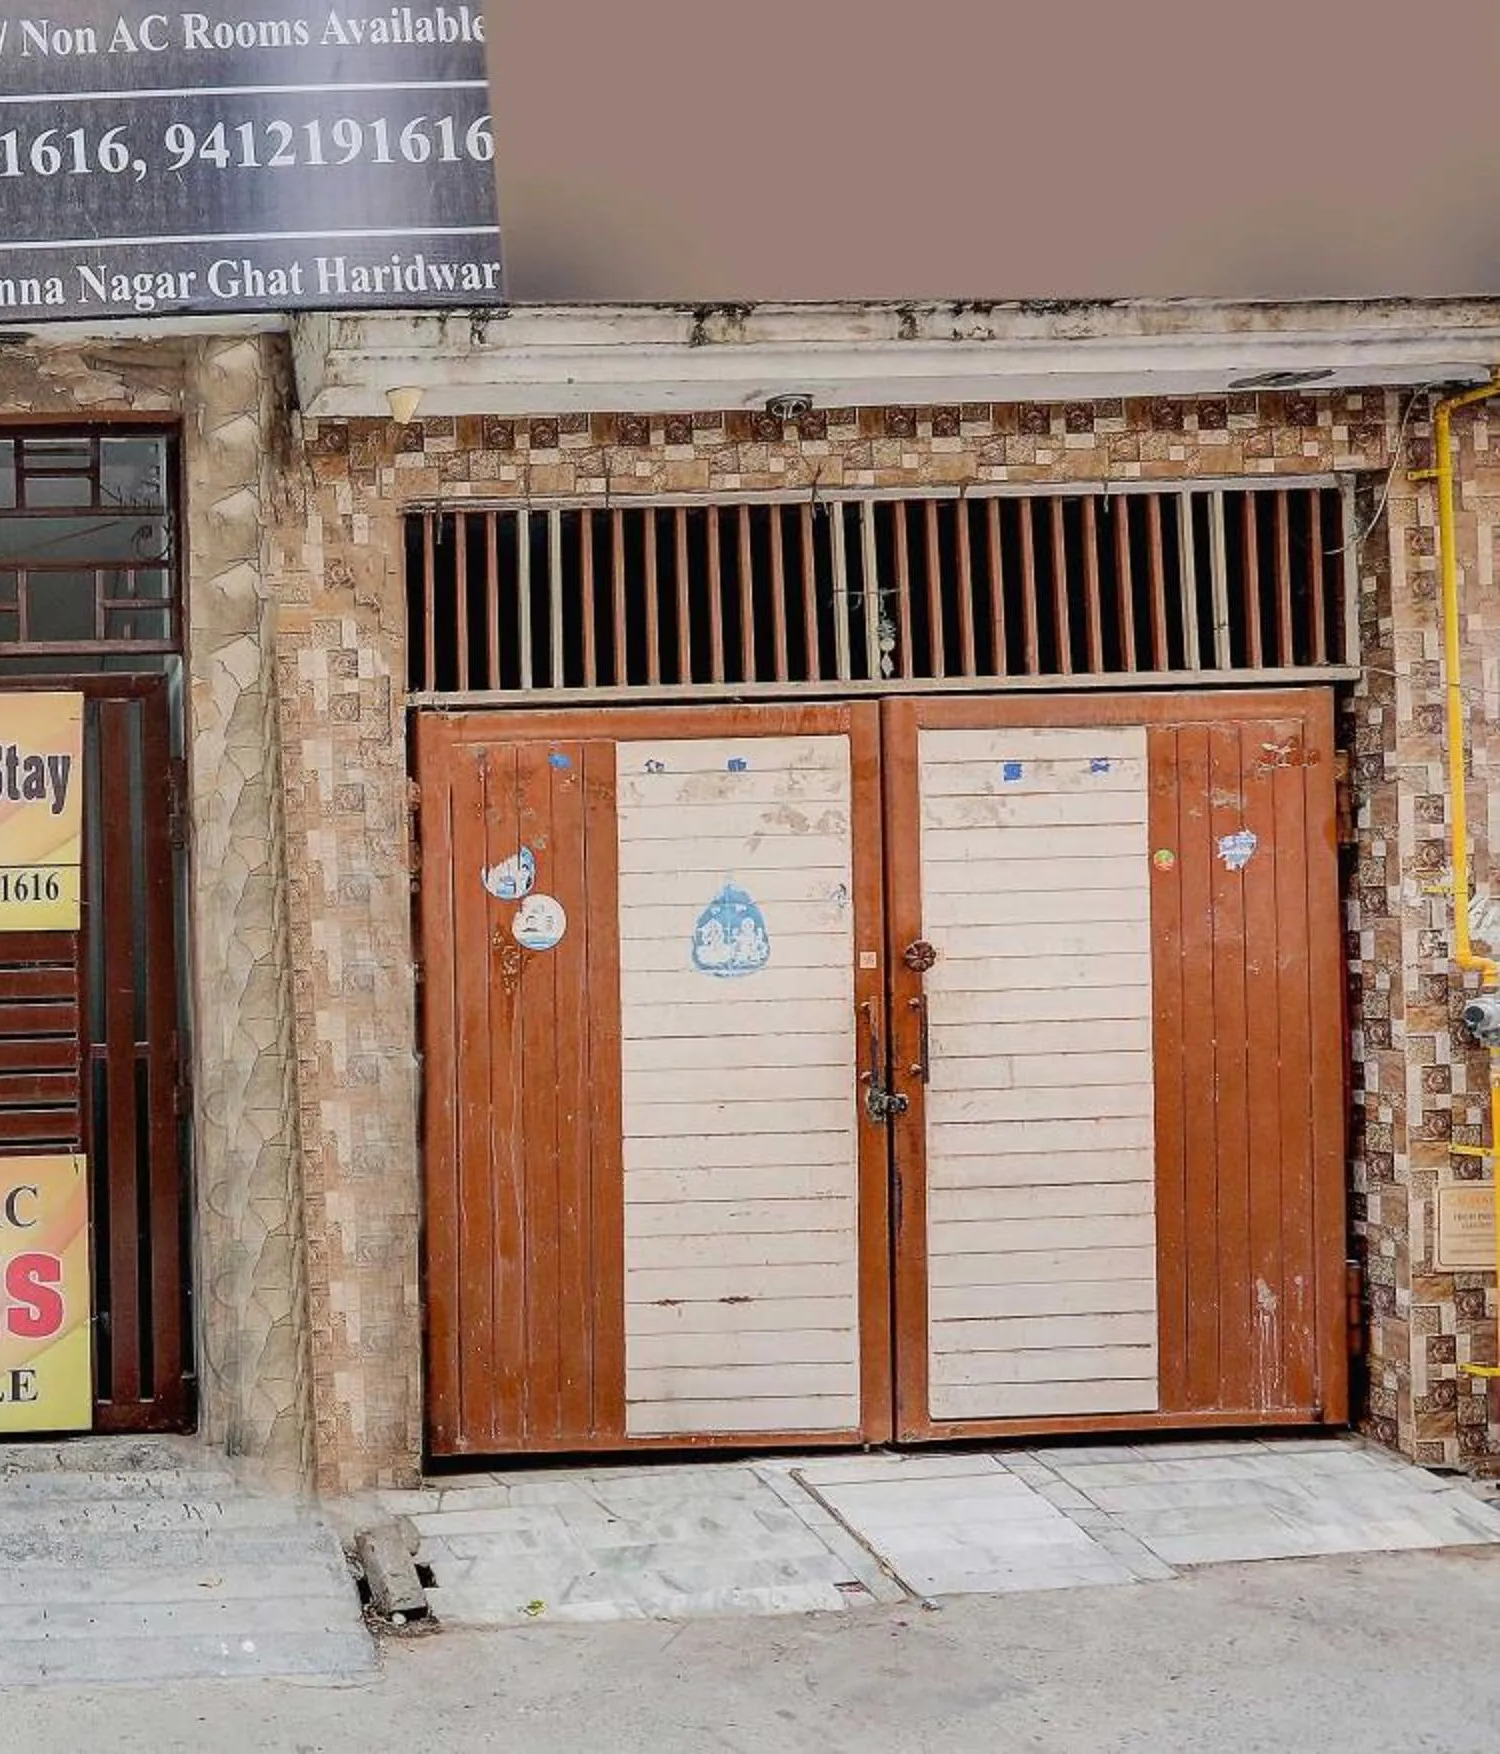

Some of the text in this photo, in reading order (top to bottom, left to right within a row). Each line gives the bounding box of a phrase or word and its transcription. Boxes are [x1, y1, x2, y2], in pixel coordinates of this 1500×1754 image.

[19, 19, 97, 57] Non
[108, 13, 169, 53] AC
[183, 10, 309, 50] Rooms
[320, 6, 485, 45] Available
[164, 115, 496, 170] 9412191616
[77, 262, 197, 312] Nagar
[206, 256, 305, 299] Ghat
[314, 254, 500, 294] Haridwar
